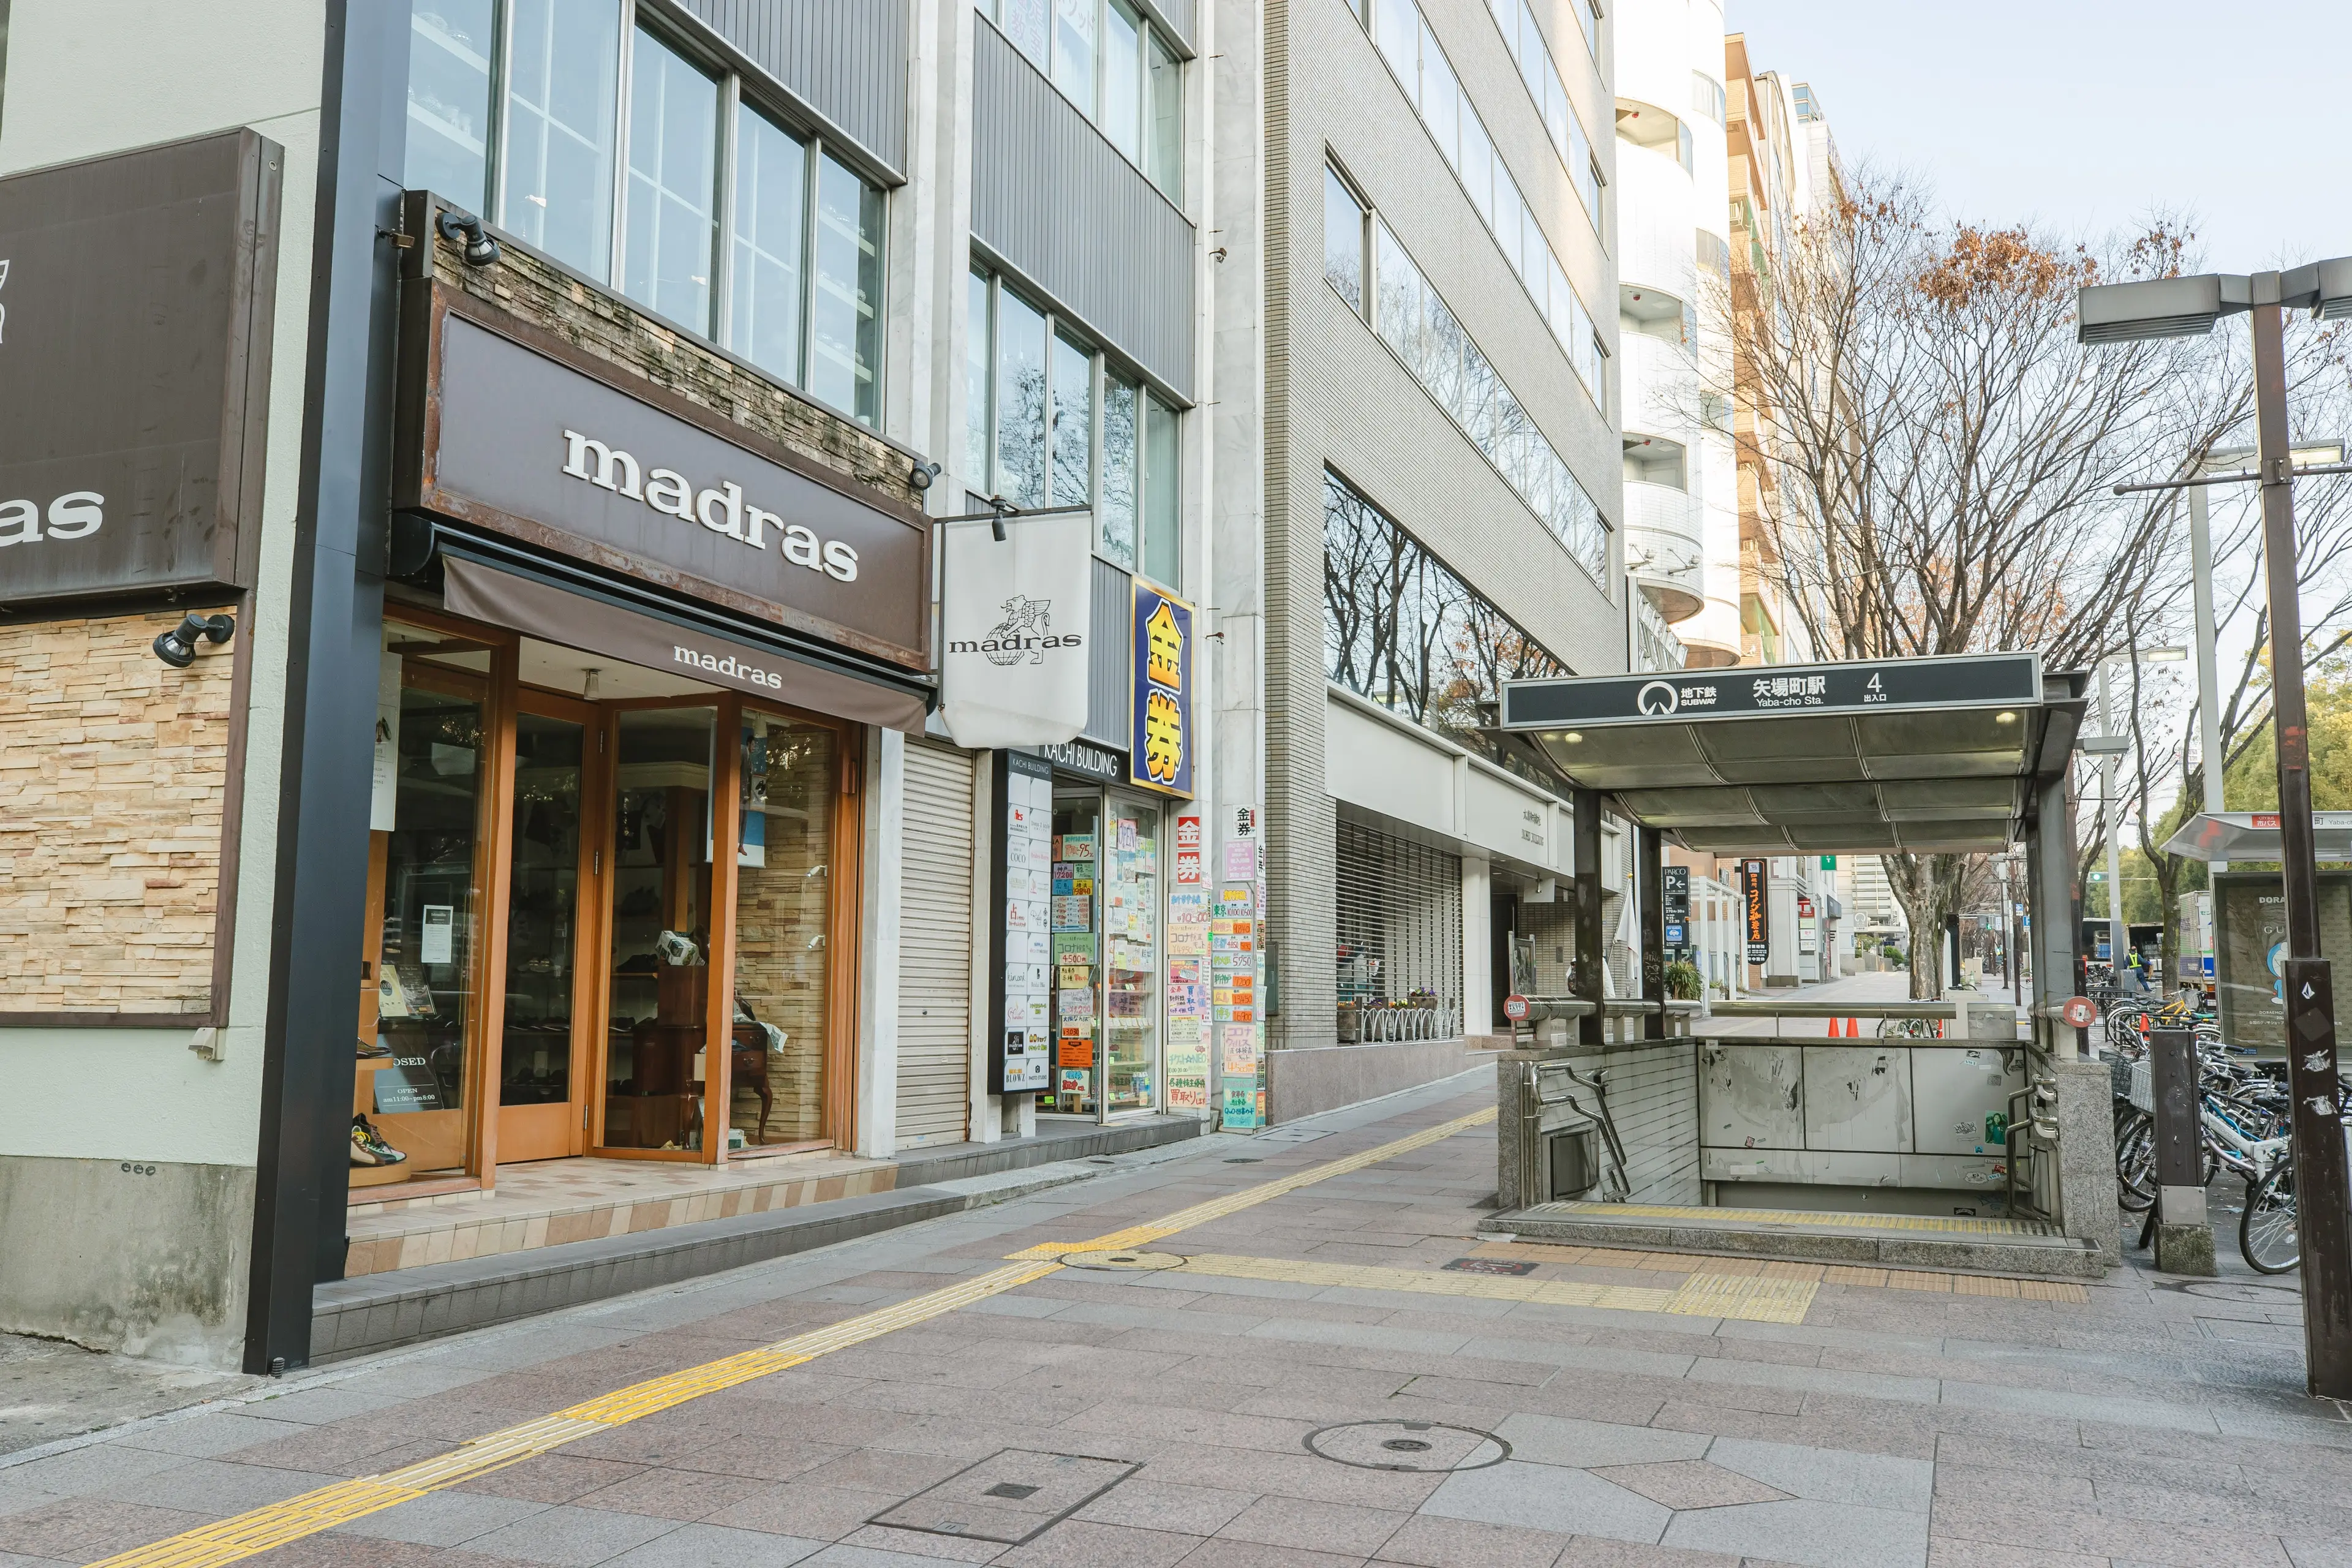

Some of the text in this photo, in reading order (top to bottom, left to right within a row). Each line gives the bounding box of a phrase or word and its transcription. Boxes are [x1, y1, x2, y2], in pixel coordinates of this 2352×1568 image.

[562, 429, 858, 582] madras
[949, 634, 1082, 654] madras
[674, 644, 782, 689] madras
[1752, 676, 1826, 698] 矢場町駅
[1867, 673, 1882, 692] 4
[1146, 599, 1183, 784] 金券
[1681, 687, 1717, 698] 地下鉄
[1681, 698, 1717, 706] SUBWAY
[1756, 696, 1823, 707] Yaba-cho Sta.
[1012, 758, 1049, 775] KACHI BUILDING
[1044, 743, 1118, 777] KACHI BUILDING
[1237, 808, 1251, 836] 金券
[1118, 823, 1135, 848] OPEN
[1177, 820, 1200, 880] 金券
[1011, 852, 1026, 863] COCO
[1666, 876, 1676, 889] P
[1214, 904, 1226, 917] 東京
[1213, 937, 1227, 949] 京都
[1062, 954, 1086, 963] 4500円
[1232, 957, 1251, 967] 5750
[1234, 977, 1251, 987] 7200
[1186, 986, 1196, 1014] 買取中
[1215, 992, 1252, 1004] 広島 13450
[1216, 1006, 1252, 1021] 博多 16900
[1227, 1027, 1252, 1037] コロナ
[1006, 1074, 1025, 1082] BLOWZ
[1169, 1078, 1205, 1088] 各種株主優待
[1170, 1089, 1205, 1105] 買取りします
